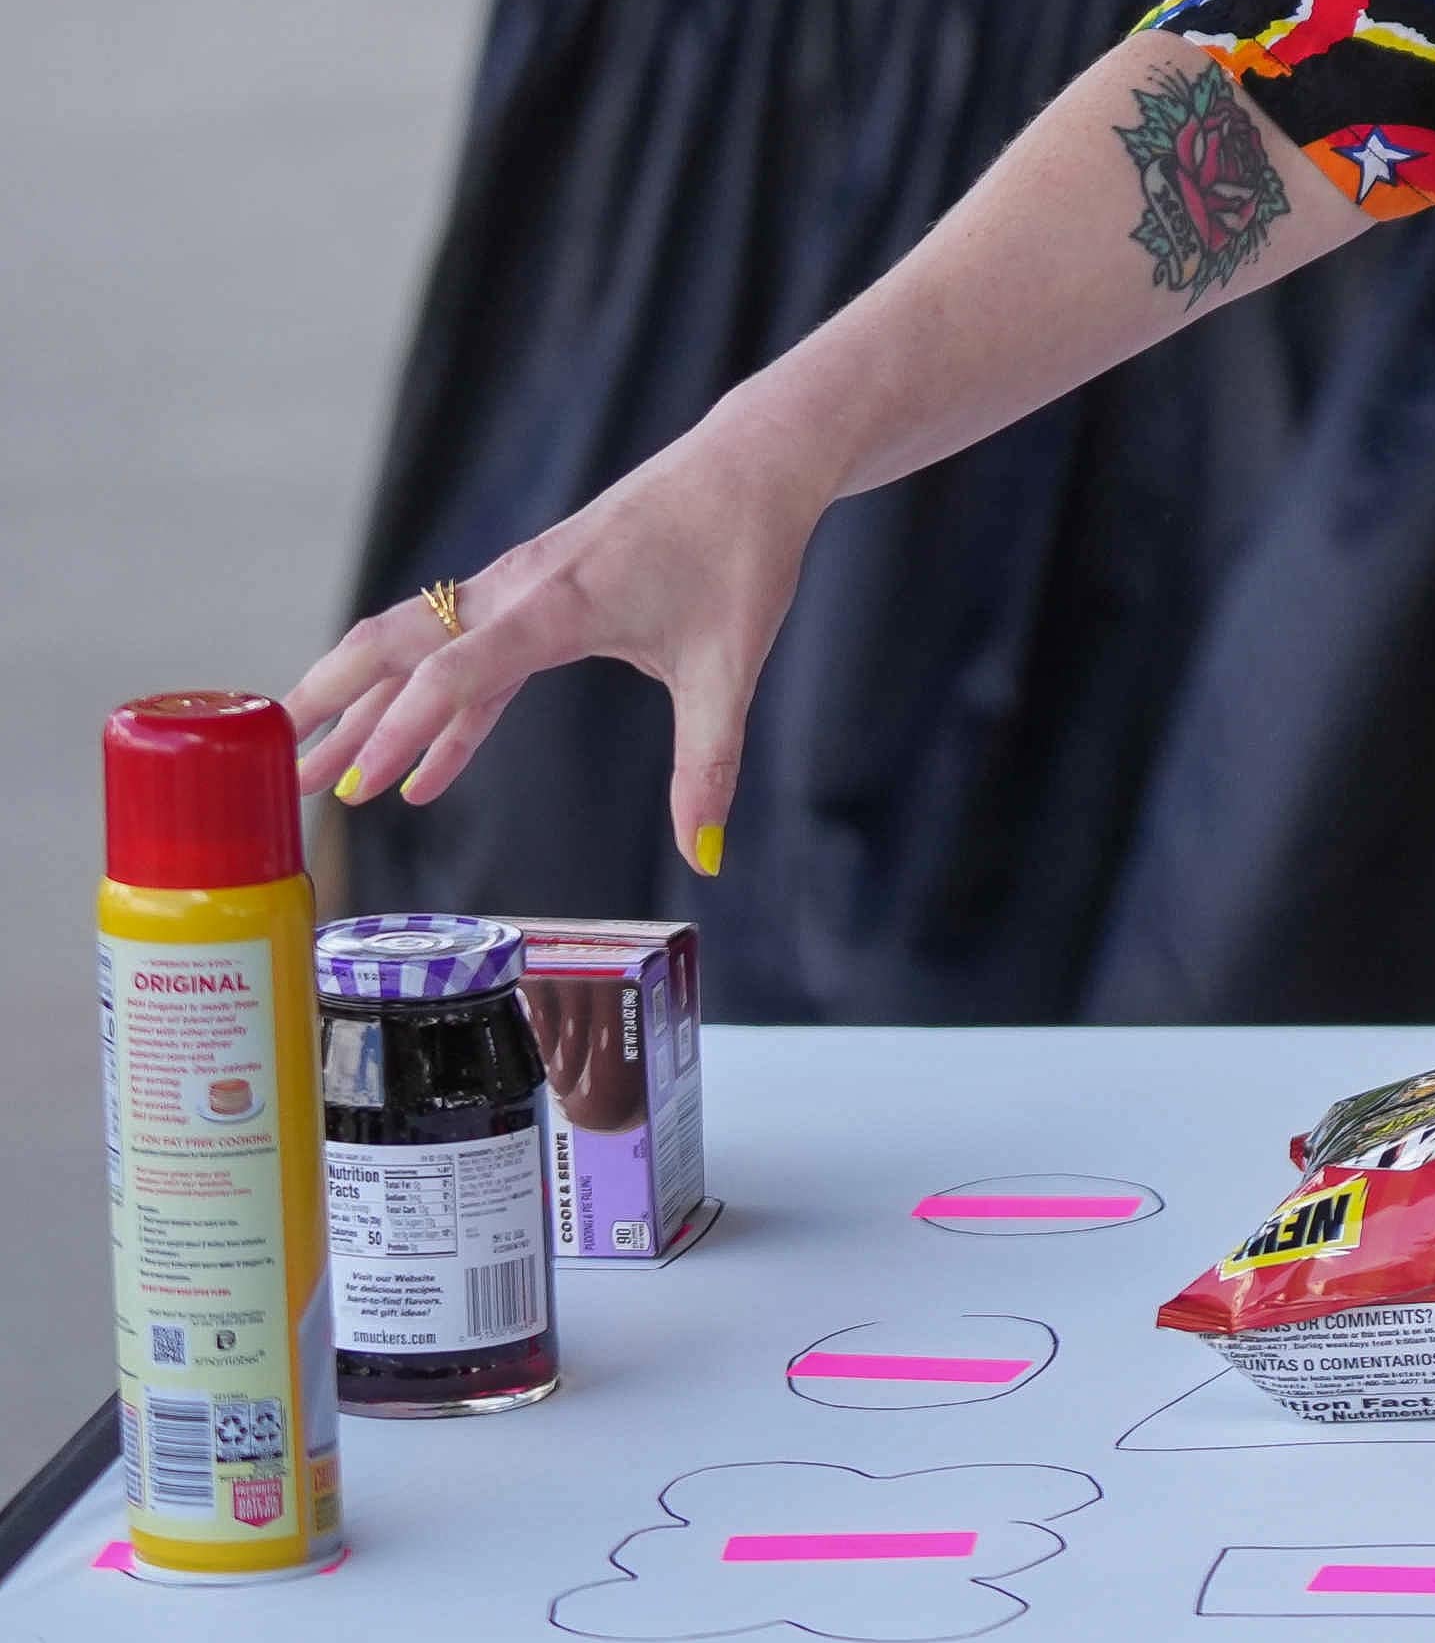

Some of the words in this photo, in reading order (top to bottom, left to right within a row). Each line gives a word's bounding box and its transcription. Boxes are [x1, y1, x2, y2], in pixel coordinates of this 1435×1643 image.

[134, 972, 250, 993] ORIGINAL
[622, 1008, 638, 1019] OZ
[623, 1032, 638, 1045] WT
[623, 1045, 639, 1060] NET
[556, 1133, 570, 1180] SERVE
[329, 1164, 380, 1183] Nutrition
[329, 1181, 361, 1200] Facts
[560, 1199, 573, 1243] COOK
[367, 1230, 383, 1246] 50
[352, 1272, 372, 1282] Visit
[376, 1274, 391, 1282] our
[395, 1274, 435, 1282] Website
[360, 1284, 401, 1294] delicious
[405, 1284, 444, 1295] recipes,
[347, 1295, 402, 1306] hard-to-find
[405, 1296, 443, 1306] flavors,
[360, 1308, 378, 1317] and
[380, 1307, 398, 1319] gift
[1325, 1308, 1434, 1331] COMMENTS?
[353, 1329, 438, 1345] smuckers.com
[1304, 1358, 1315, 1372] O
